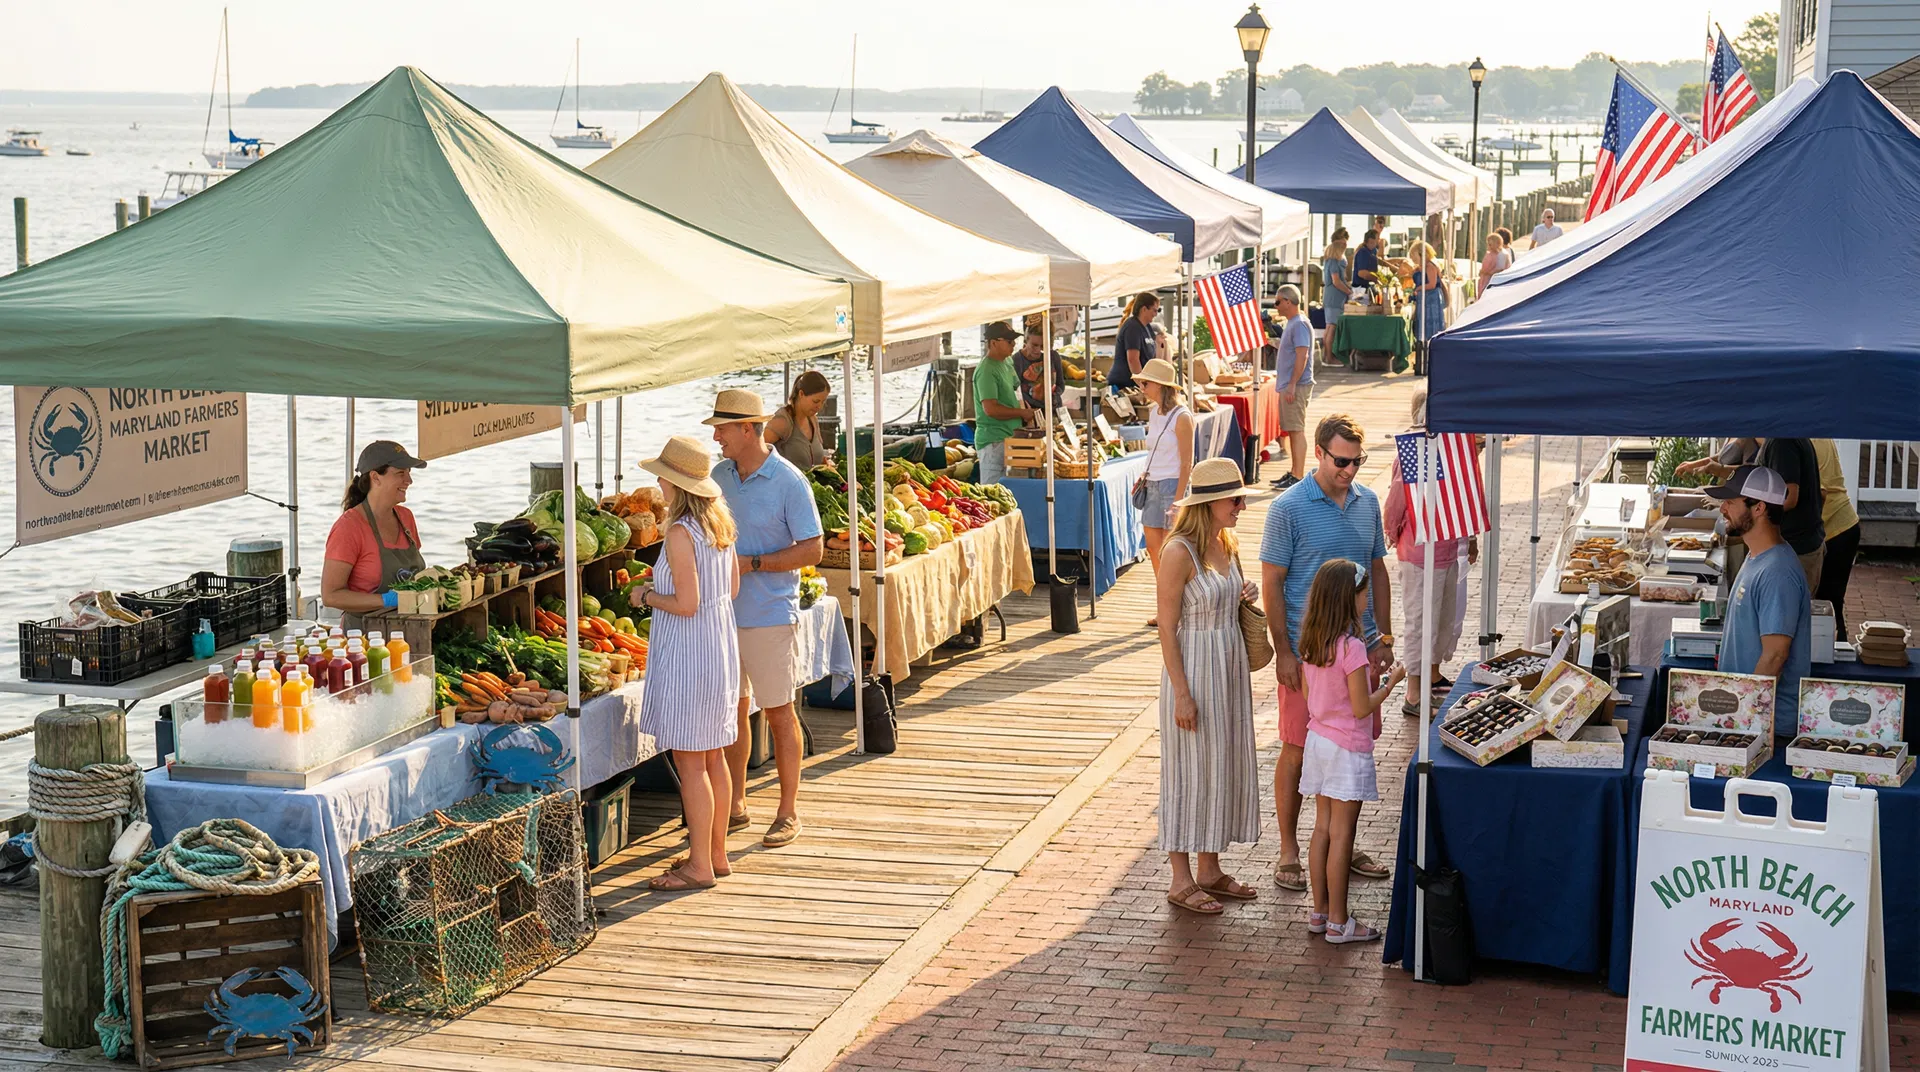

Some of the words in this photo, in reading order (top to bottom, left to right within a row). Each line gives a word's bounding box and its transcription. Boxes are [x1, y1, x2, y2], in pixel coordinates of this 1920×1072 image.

[109, 388, 173, 411] NORTH
[110, 410, 181, 438] MARYLAND
[184, 400, 239, 424] FARMERS
[144, 430, 210, 463] MARKET
[1650, 855, 1748, 909] NORTH
[1759, 858, 1855, 927] BEACH
[1709, 897, 1794, 916] MARYLAND
[1641, 1005, 1743, 1046] FARMERS
[1751, 1019, 1846, 1059] MARKET
[1752, 1056, 1779, 1068] 2025
